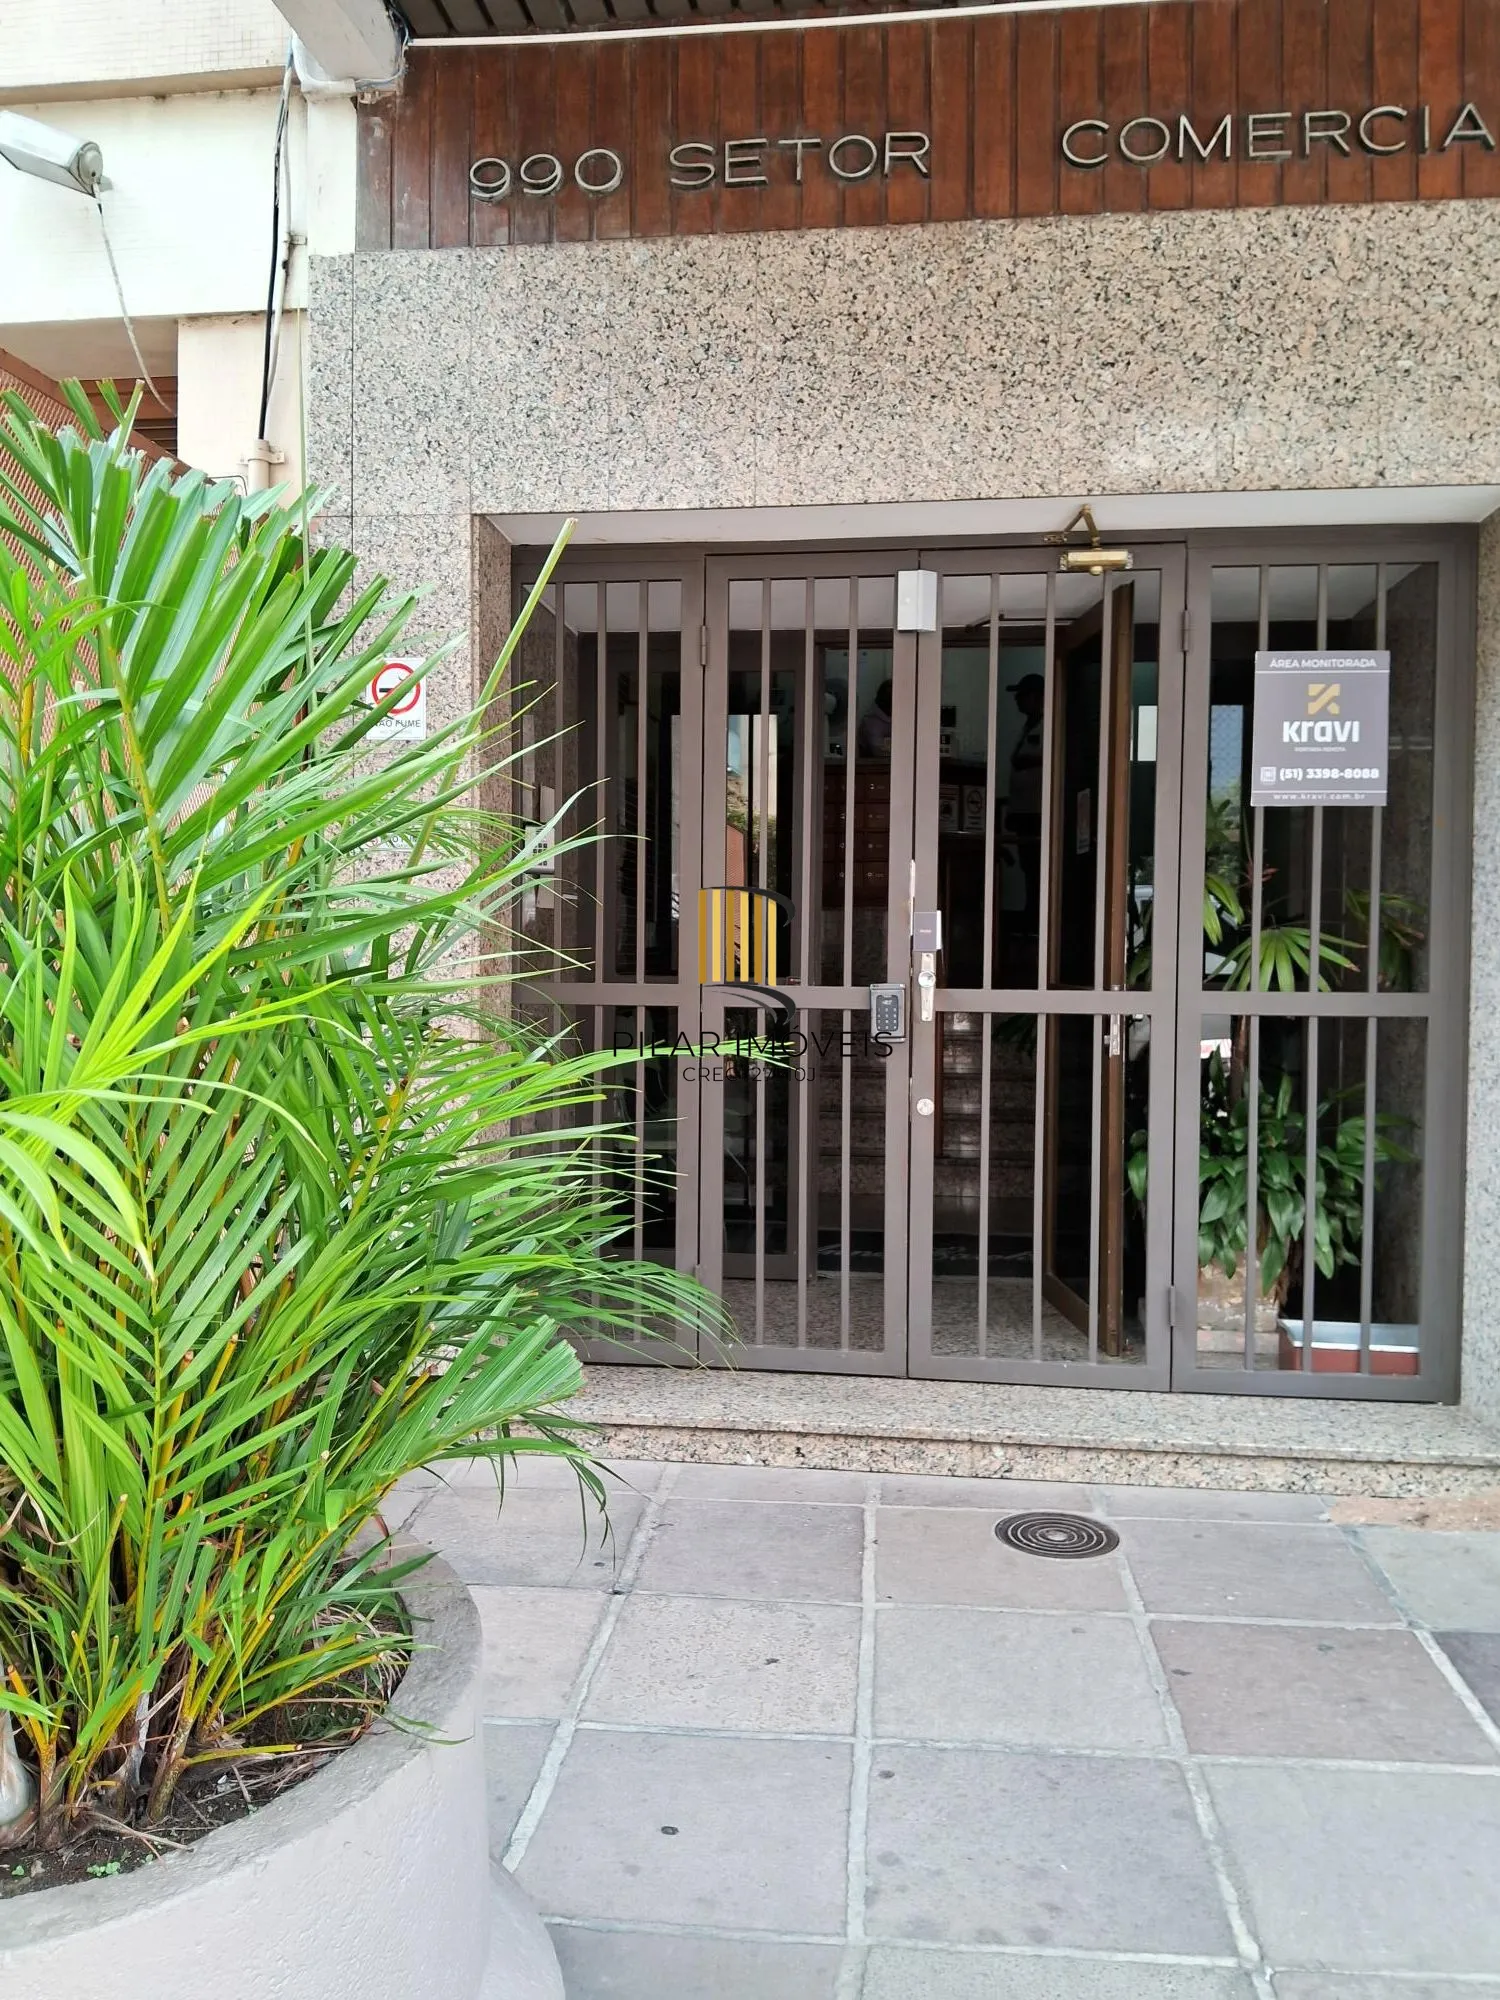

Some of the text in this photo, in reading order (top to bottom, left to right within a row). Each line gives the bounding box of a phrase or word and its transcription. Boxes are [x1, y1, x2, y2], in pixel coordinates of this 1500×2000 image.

[469, 102, 1496, 200] 990 SETOR COMERCIA
[1301, 658, 1377, 668] MONITORADA
[1279, 768, 1303, 781] (51)
